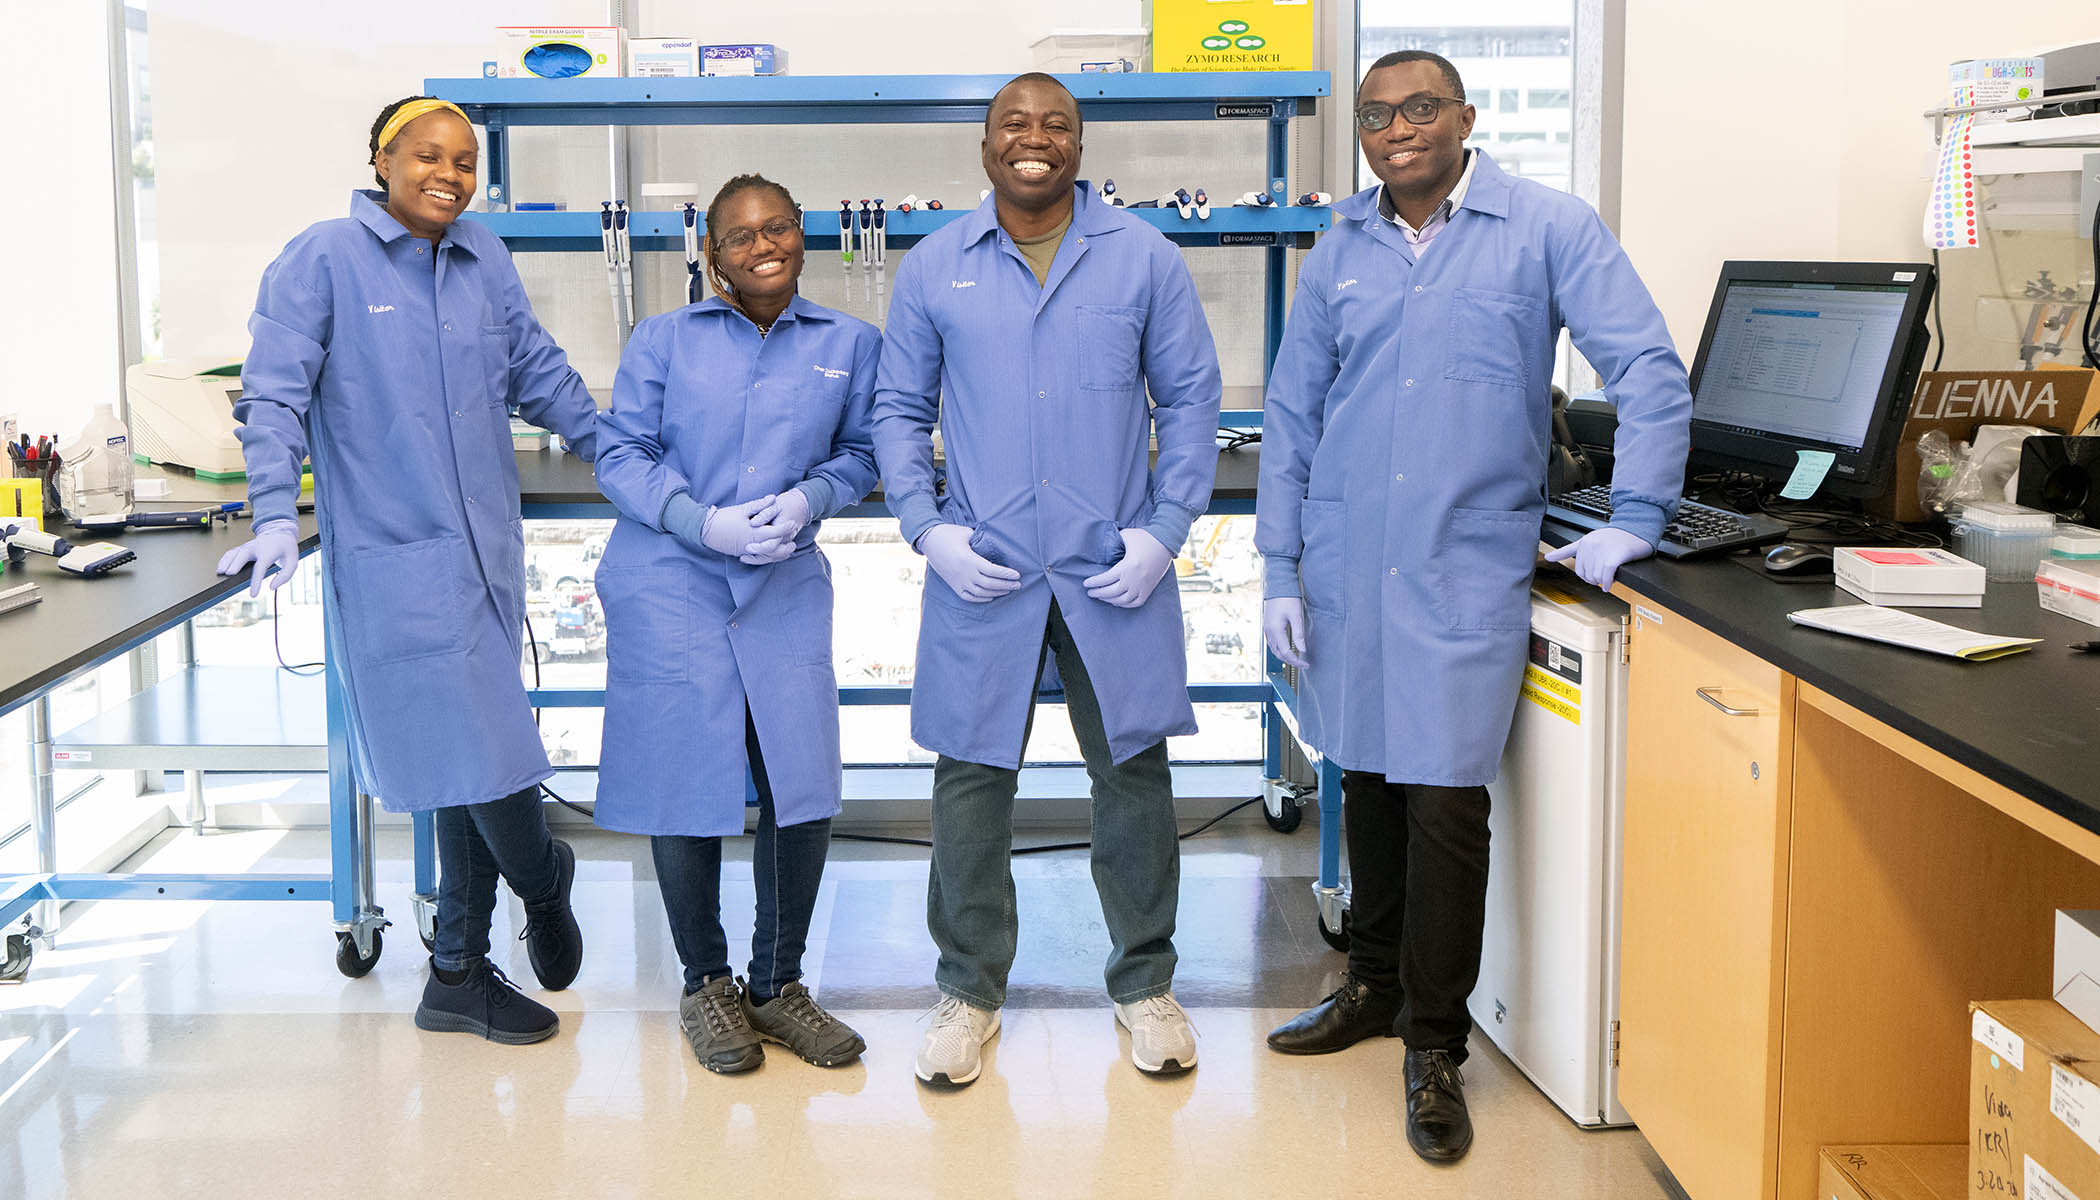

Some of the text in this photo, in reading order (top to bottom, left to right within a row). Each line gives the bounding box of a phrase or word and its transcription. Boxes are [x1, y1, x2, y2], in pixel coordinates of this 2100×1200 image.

[1186, 53, 1280, 63] ZYMO RESEARCH
[1228, 107, 1270, 115] FORMASPACE
[1913, 378, 2059, 420] LIENNA
